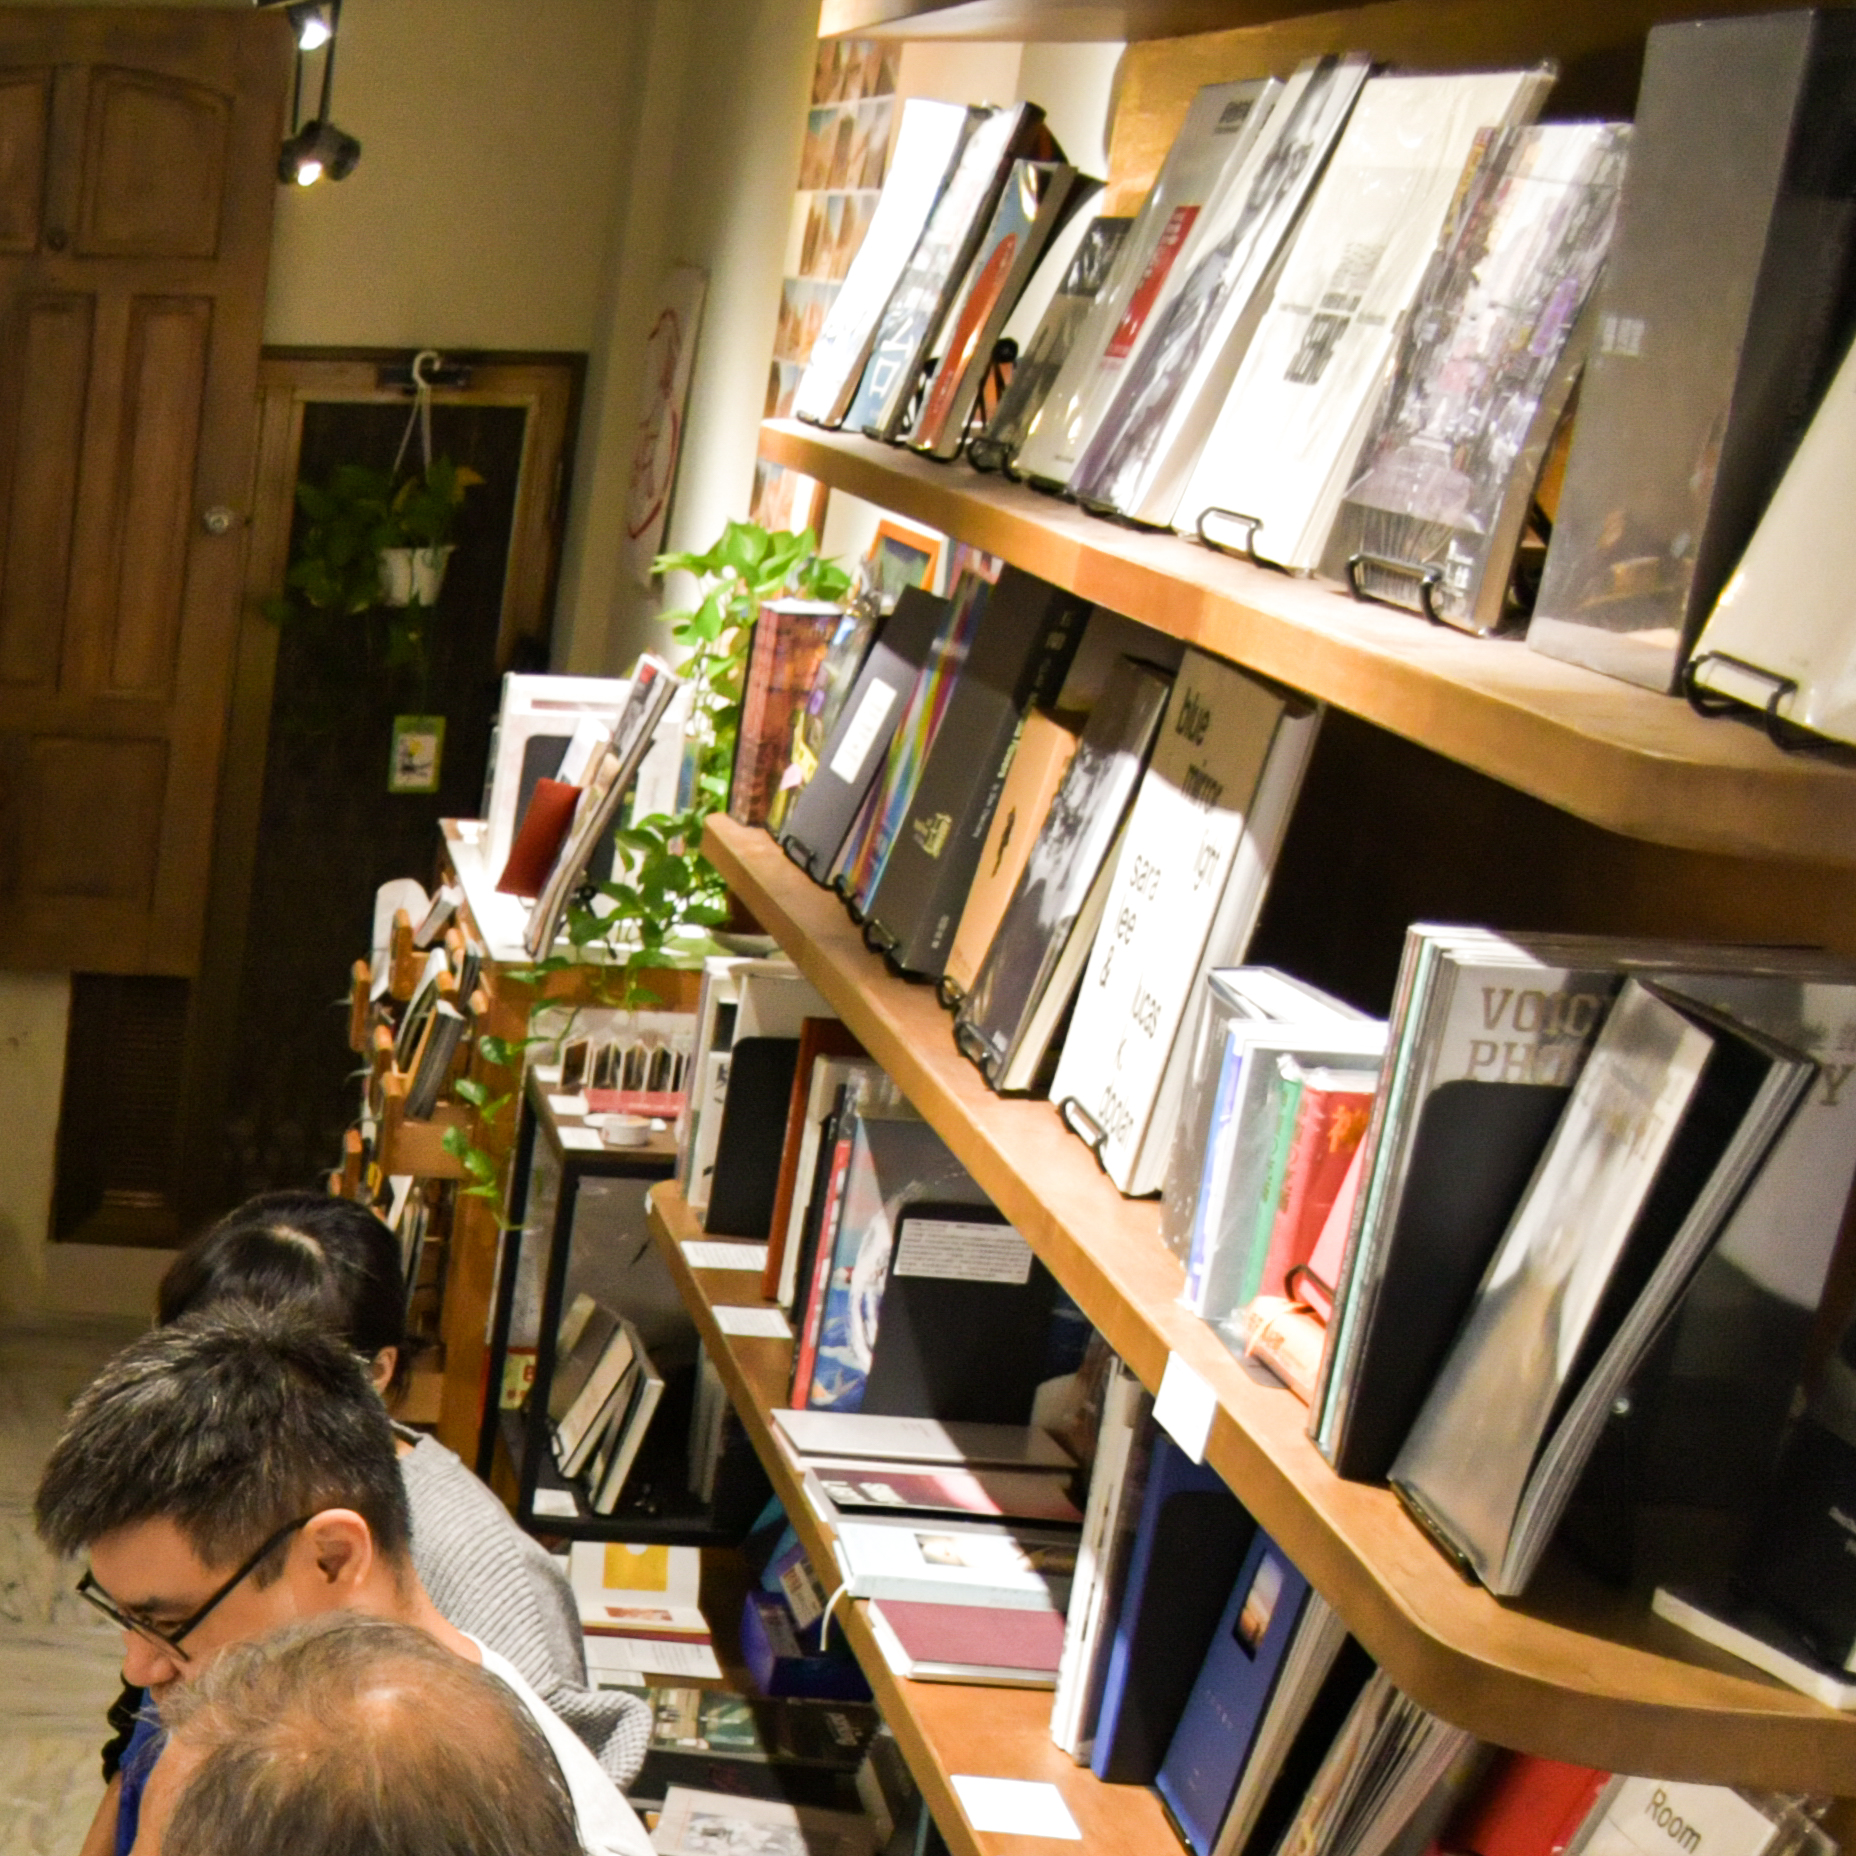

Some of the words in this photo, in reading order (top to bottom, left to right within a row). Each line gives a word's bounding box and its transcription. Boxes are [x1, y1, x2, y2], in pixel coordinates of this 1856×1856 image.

[1175, 687, 1211, 749] blue
[1130, 854, 1161, 901] sara
[1193, 829, 1221, 892] light
[1114, 892, 1137, 946] lee
[1131, 970, 1161, 1039] lucas
[1482, 986, 1598, 1039] VOIC
[1645, 1788, 1702, 1854] Room
